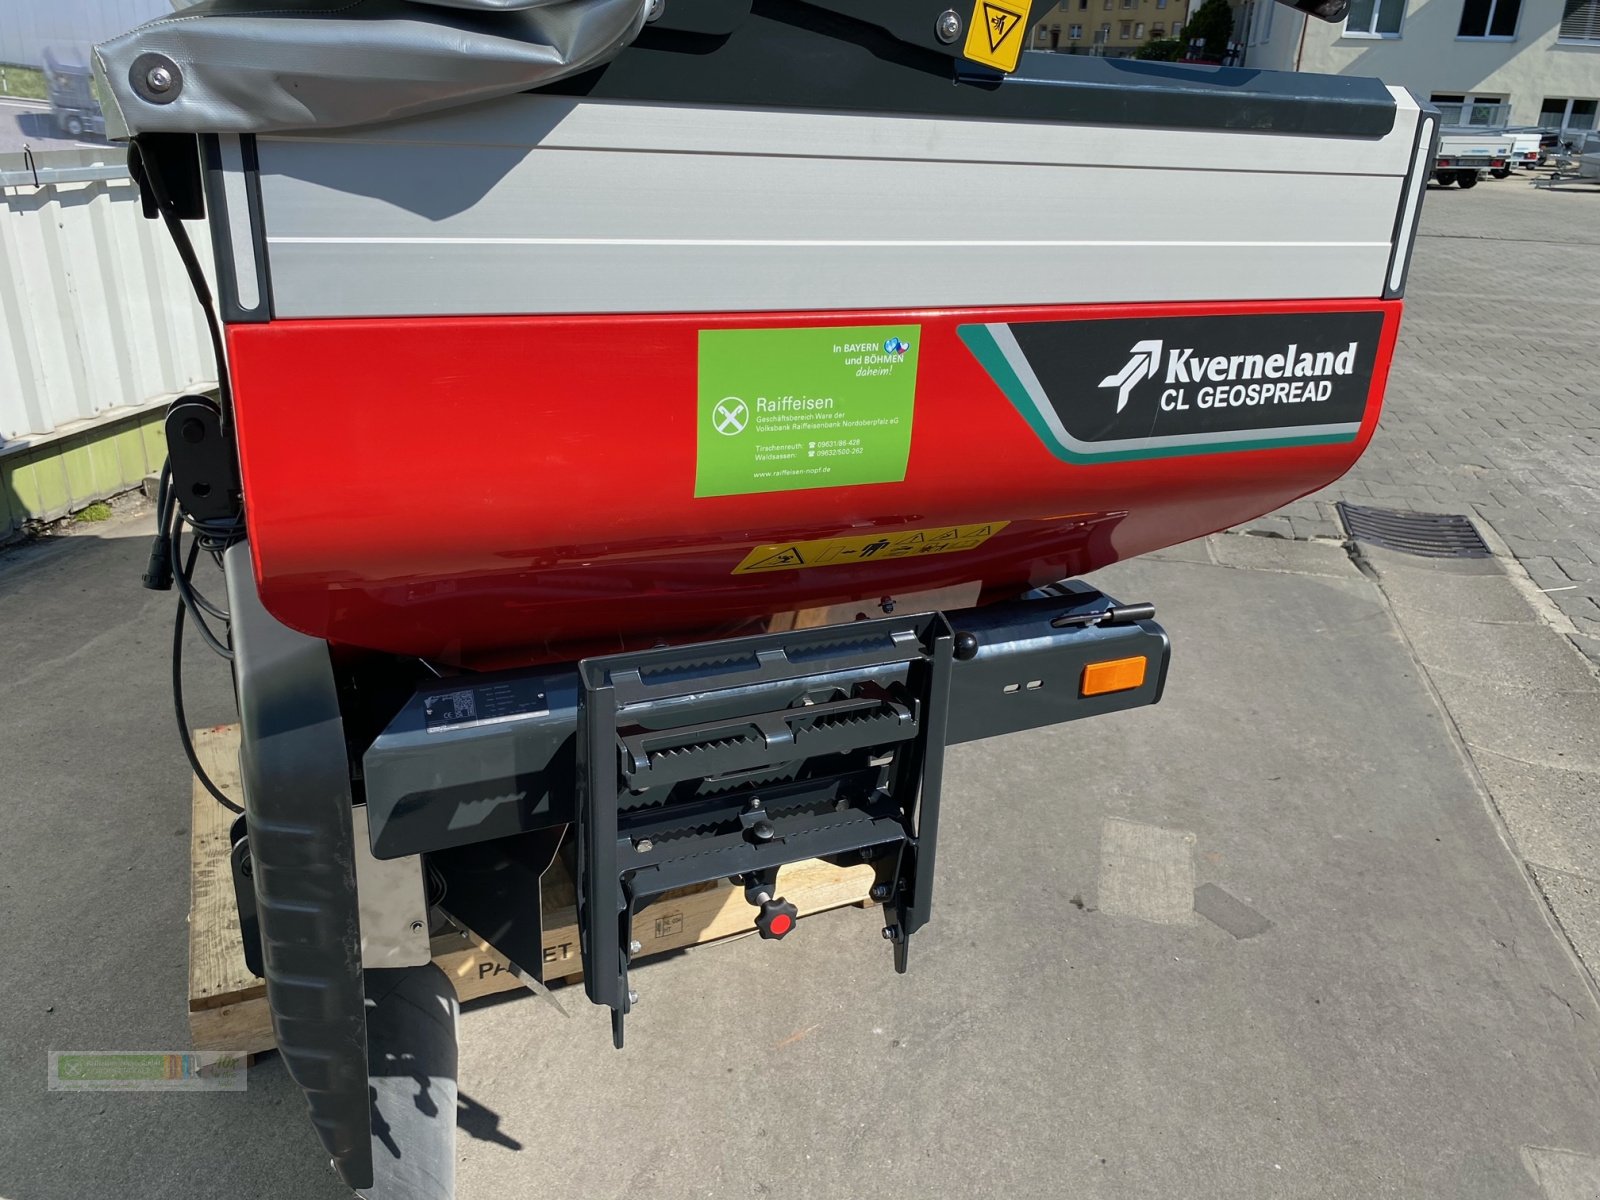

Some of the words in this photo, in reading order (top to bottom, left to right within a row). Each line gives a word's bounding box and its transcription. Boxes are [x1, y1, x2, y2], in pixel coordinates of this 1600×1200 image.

[833, 344, 841, 353] In
[844, 342, 879, 353] BAYERN
[845, 355, 862, 365] und
[864, 353, 904, 365] BÖHMEN
[1164, 342, 1358, 384] Kverneland
[856, 365, 893, 377] daheim!
[1160, 387, 1190, 412] CL
[1197, 380, 1332, 409] GEOSPREAD
[756, 396, 834, 412] Raiffeisen
[756, 413, 814, 423] Geschäftsbereich
[815, 412, 833, 420] Ware
[756, 422, 790, 432] Volksbank
[792, 420, 841, 431] Raiffeisenbank
[842, 418, 889, 429] Nordoberpfalz
[889, 417, 899, 425] eG
